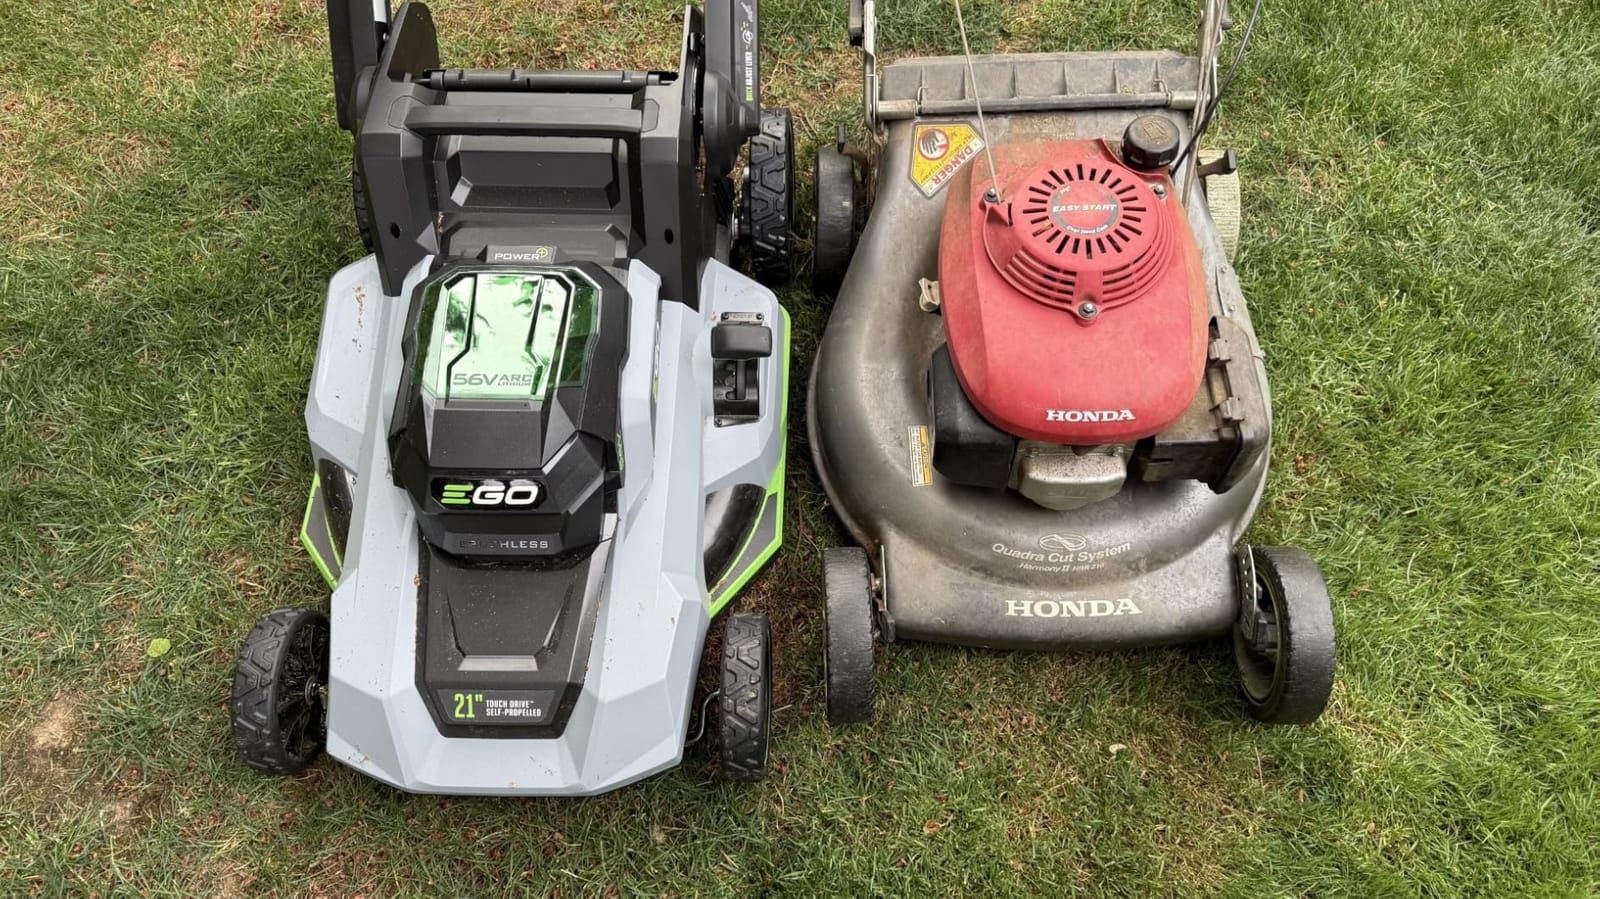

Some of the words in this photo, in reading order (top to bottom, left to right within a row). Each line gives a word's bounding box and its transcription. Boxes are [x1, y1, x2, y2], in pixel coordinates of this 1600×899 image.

[932, 145, 974, 185] DANGER
[1052, 204, 1080, 212] EASY
[1082, 203, 1117, 211] START
[452, 373, 498, 386] 56V
[499, 373, 533, 382] ARC
[1046, 409, 1136, 422] HONDA
[441, 484, 538, 505] EGO
[991, 543, 1045, 562] Quadra
[1048, 552, 1074, 563] Cut
[1077, 542, 1131, 563] System
[1019, 562, 1061, 573] Harmony
[1005, 598, 1143, 618] HONDA
[454, 693, 483, 718] 21"
[486, 700, 508, 708] TOUCH
[486, 708, 542, 717] SELF-PROPELLED
